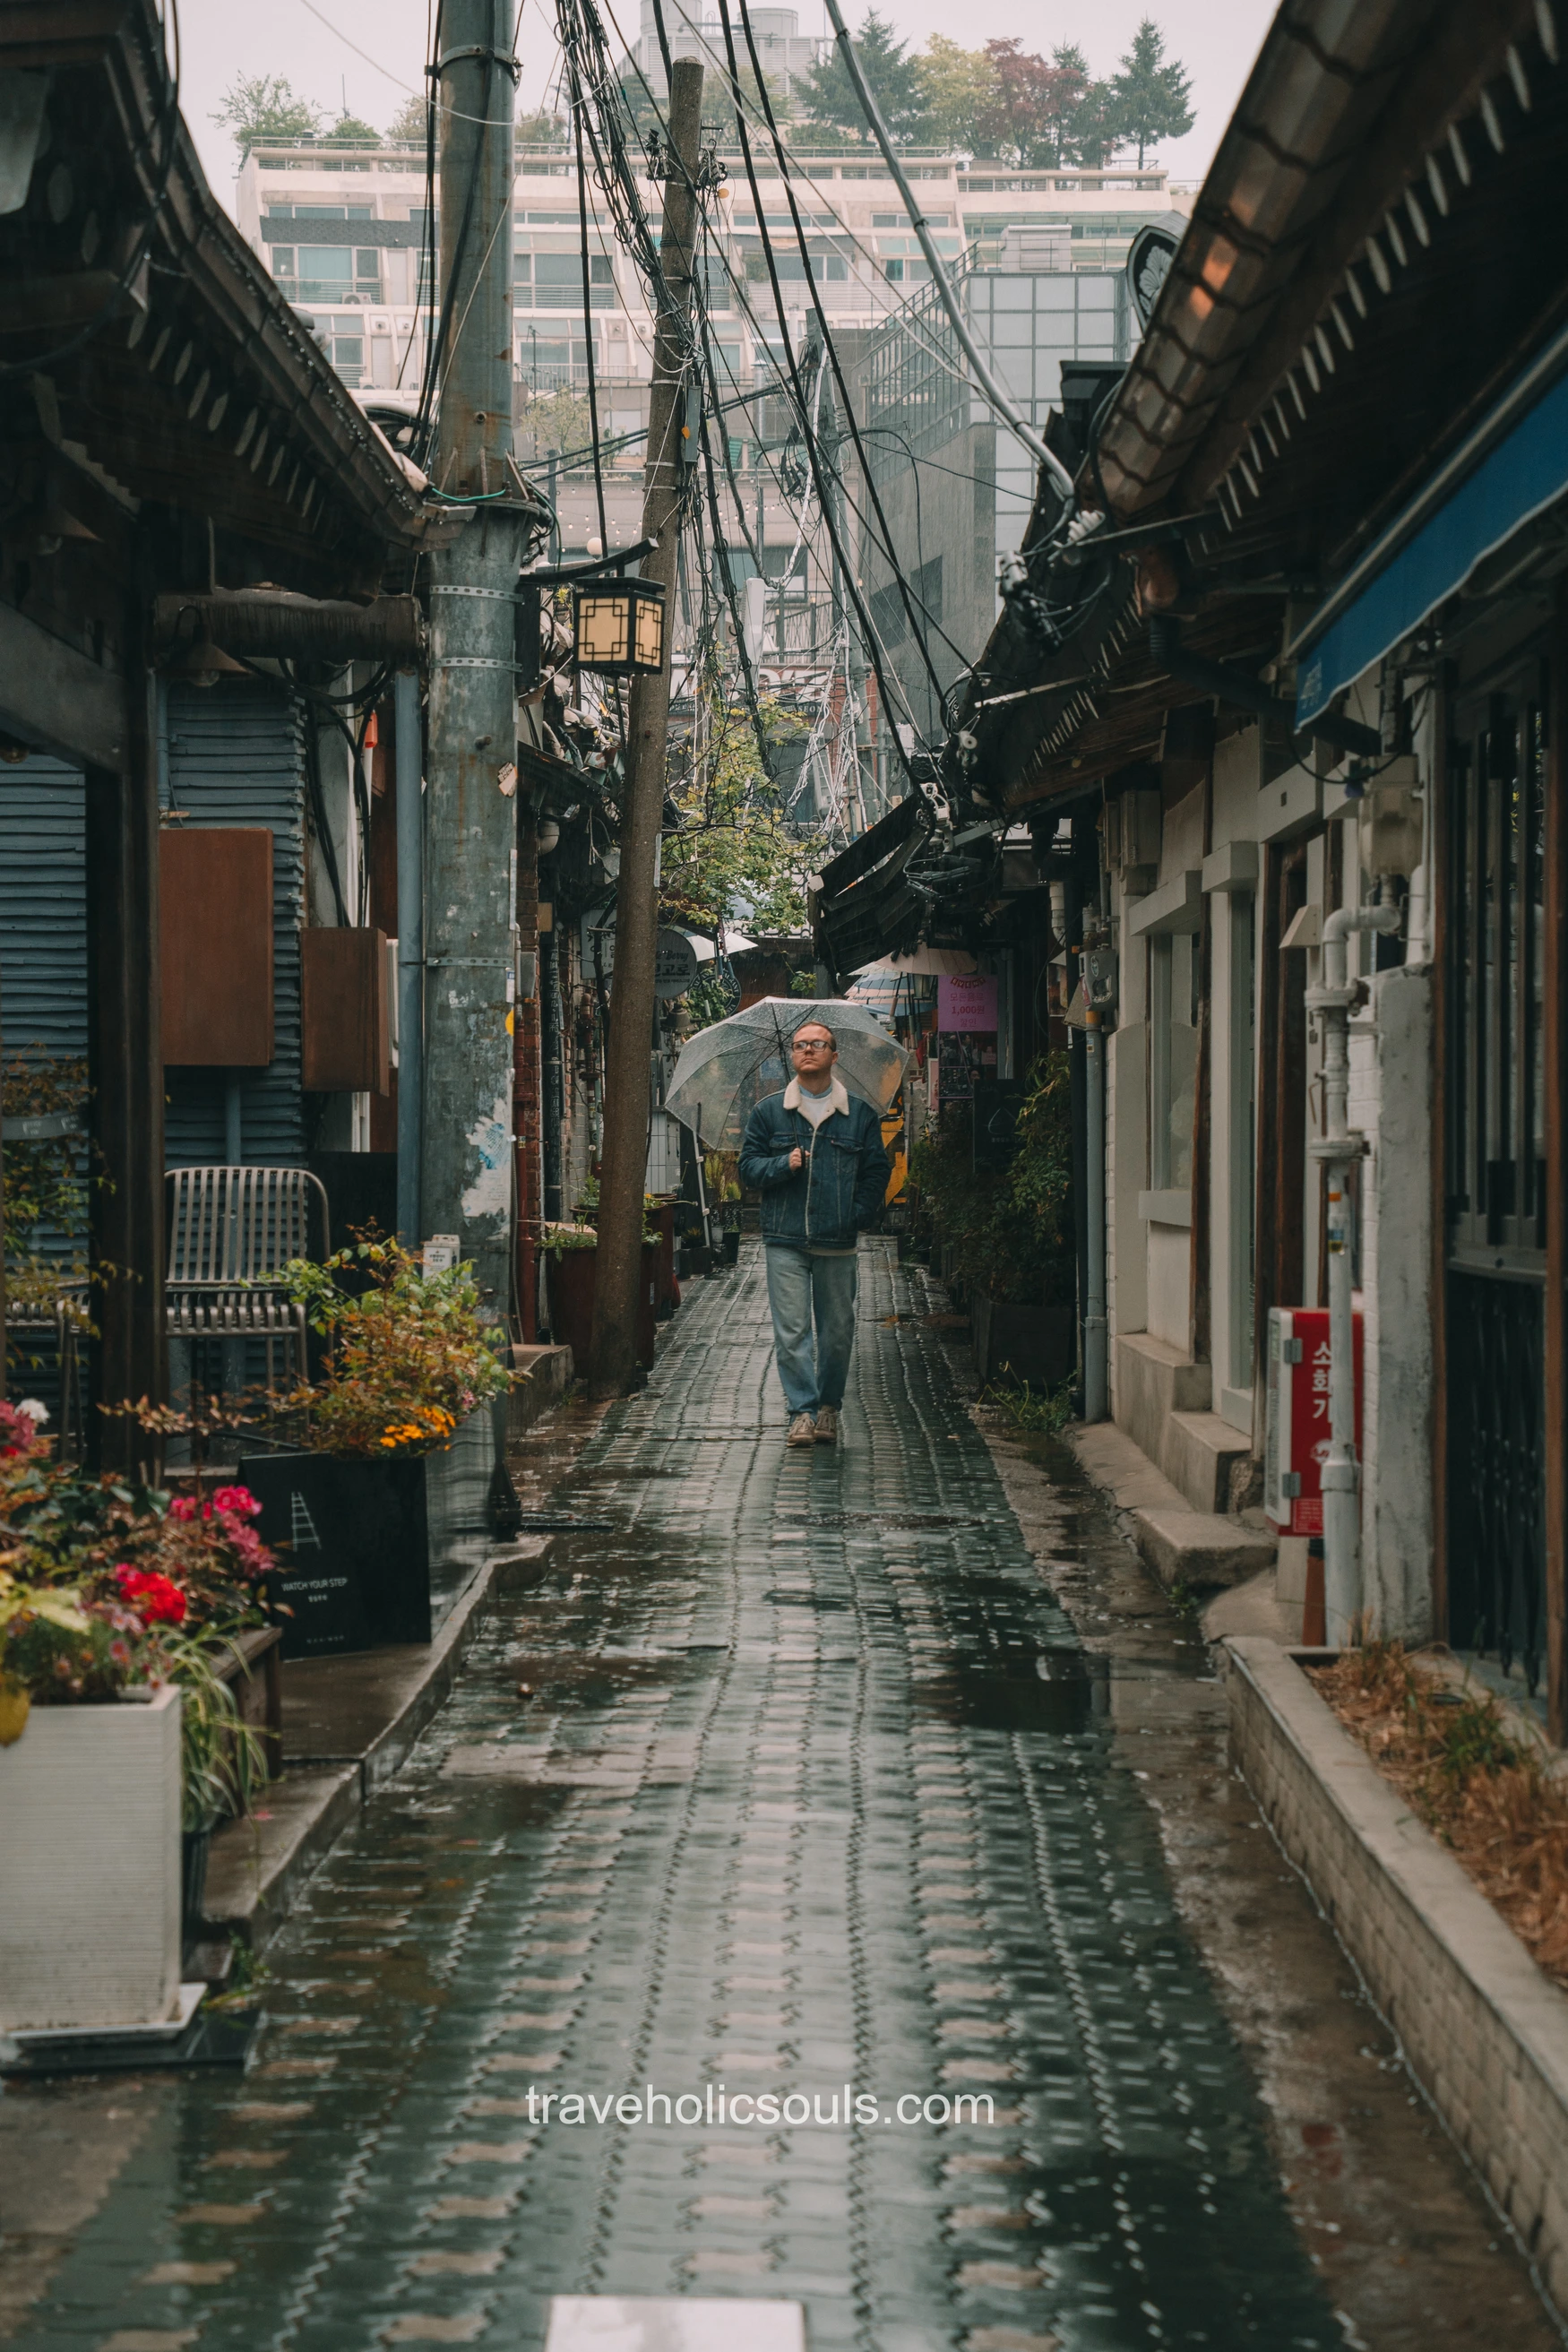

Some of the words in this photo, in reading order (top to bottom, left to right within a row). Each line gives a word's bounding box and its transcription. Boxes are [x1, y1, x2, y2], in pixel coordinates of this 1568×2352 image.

[952, 977, 985, 987] EVENT
[952, 1005, 985, 1016] 1,000원
[1312, 1340, 1333, 1424] 소화기
[281, 1581, 308, 1591] WATCH
[308, 1579, 329, 1590] YOUR
[329, 1577, 348, 1588] STEP
